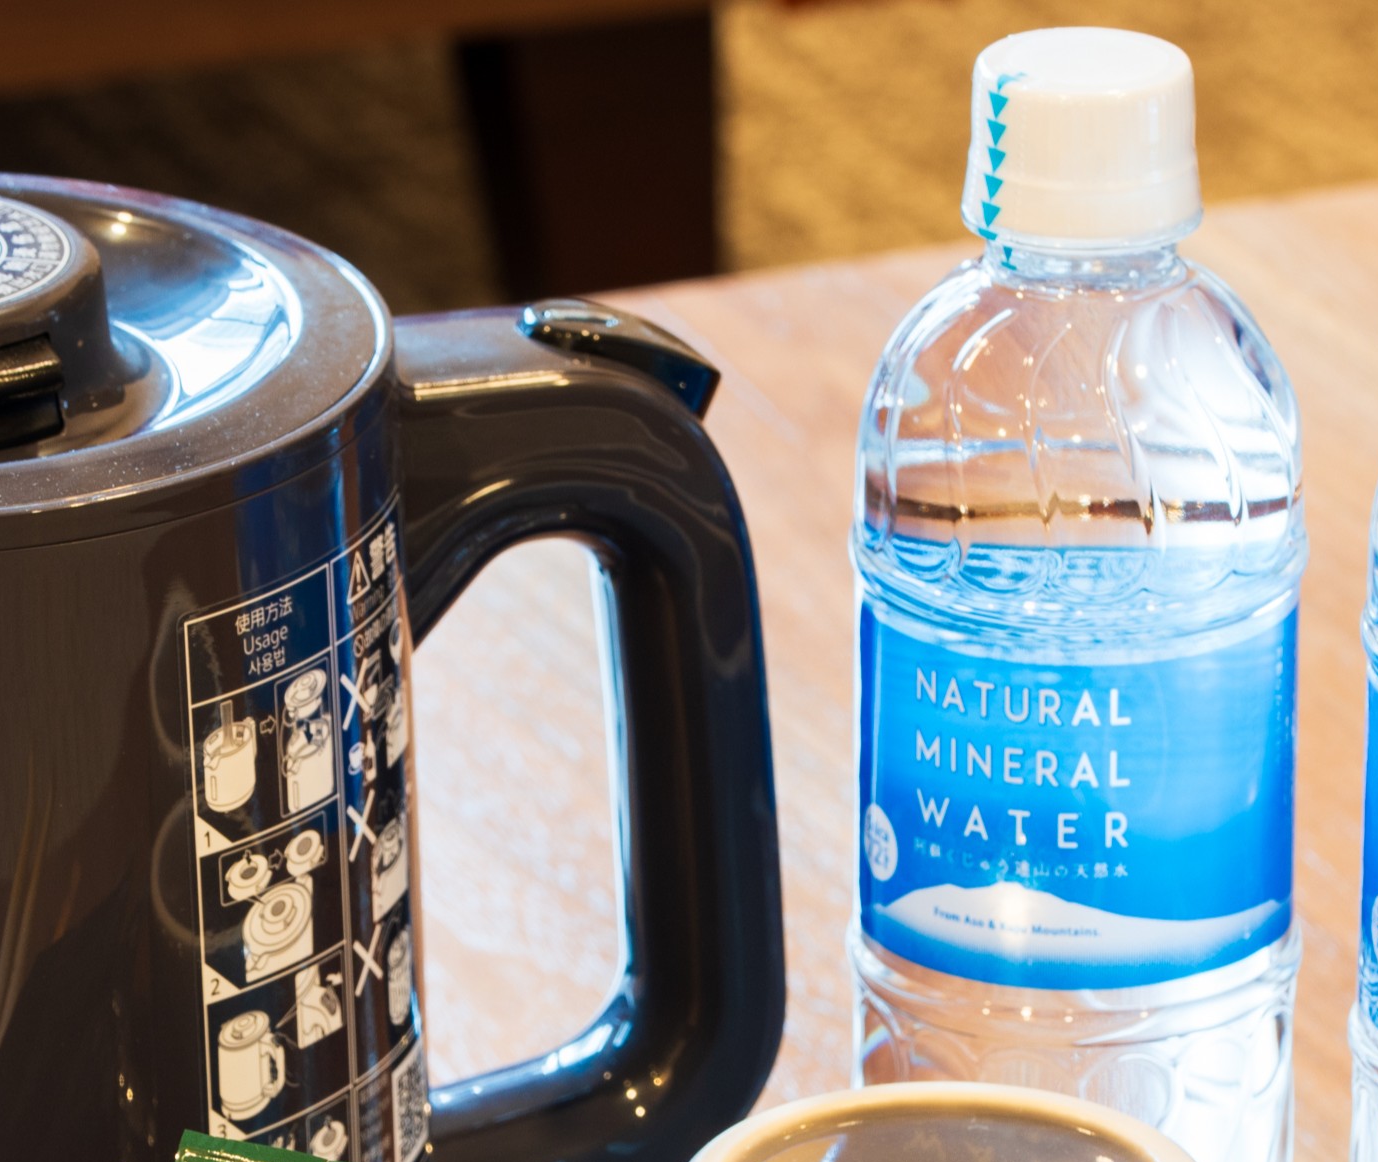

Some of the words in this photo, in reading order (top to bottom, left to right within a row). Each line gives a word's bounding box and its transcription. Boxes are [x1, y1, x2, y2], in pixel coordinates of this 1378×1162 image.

[235, 596, 293, 635] 使用方法
[243, 625, 288, 655] Usage
[248, 646, 286, 676] 사용법
[916, 666, 1132, 727] NATURAL
[915, 729, 1131, 789] MINERAL
[916, 788, 1129, 849] WATER
[203, 831, 211, 848] 1
[210, 978, 220, 995] 2
[217, 1123, 227, 1138] 3
